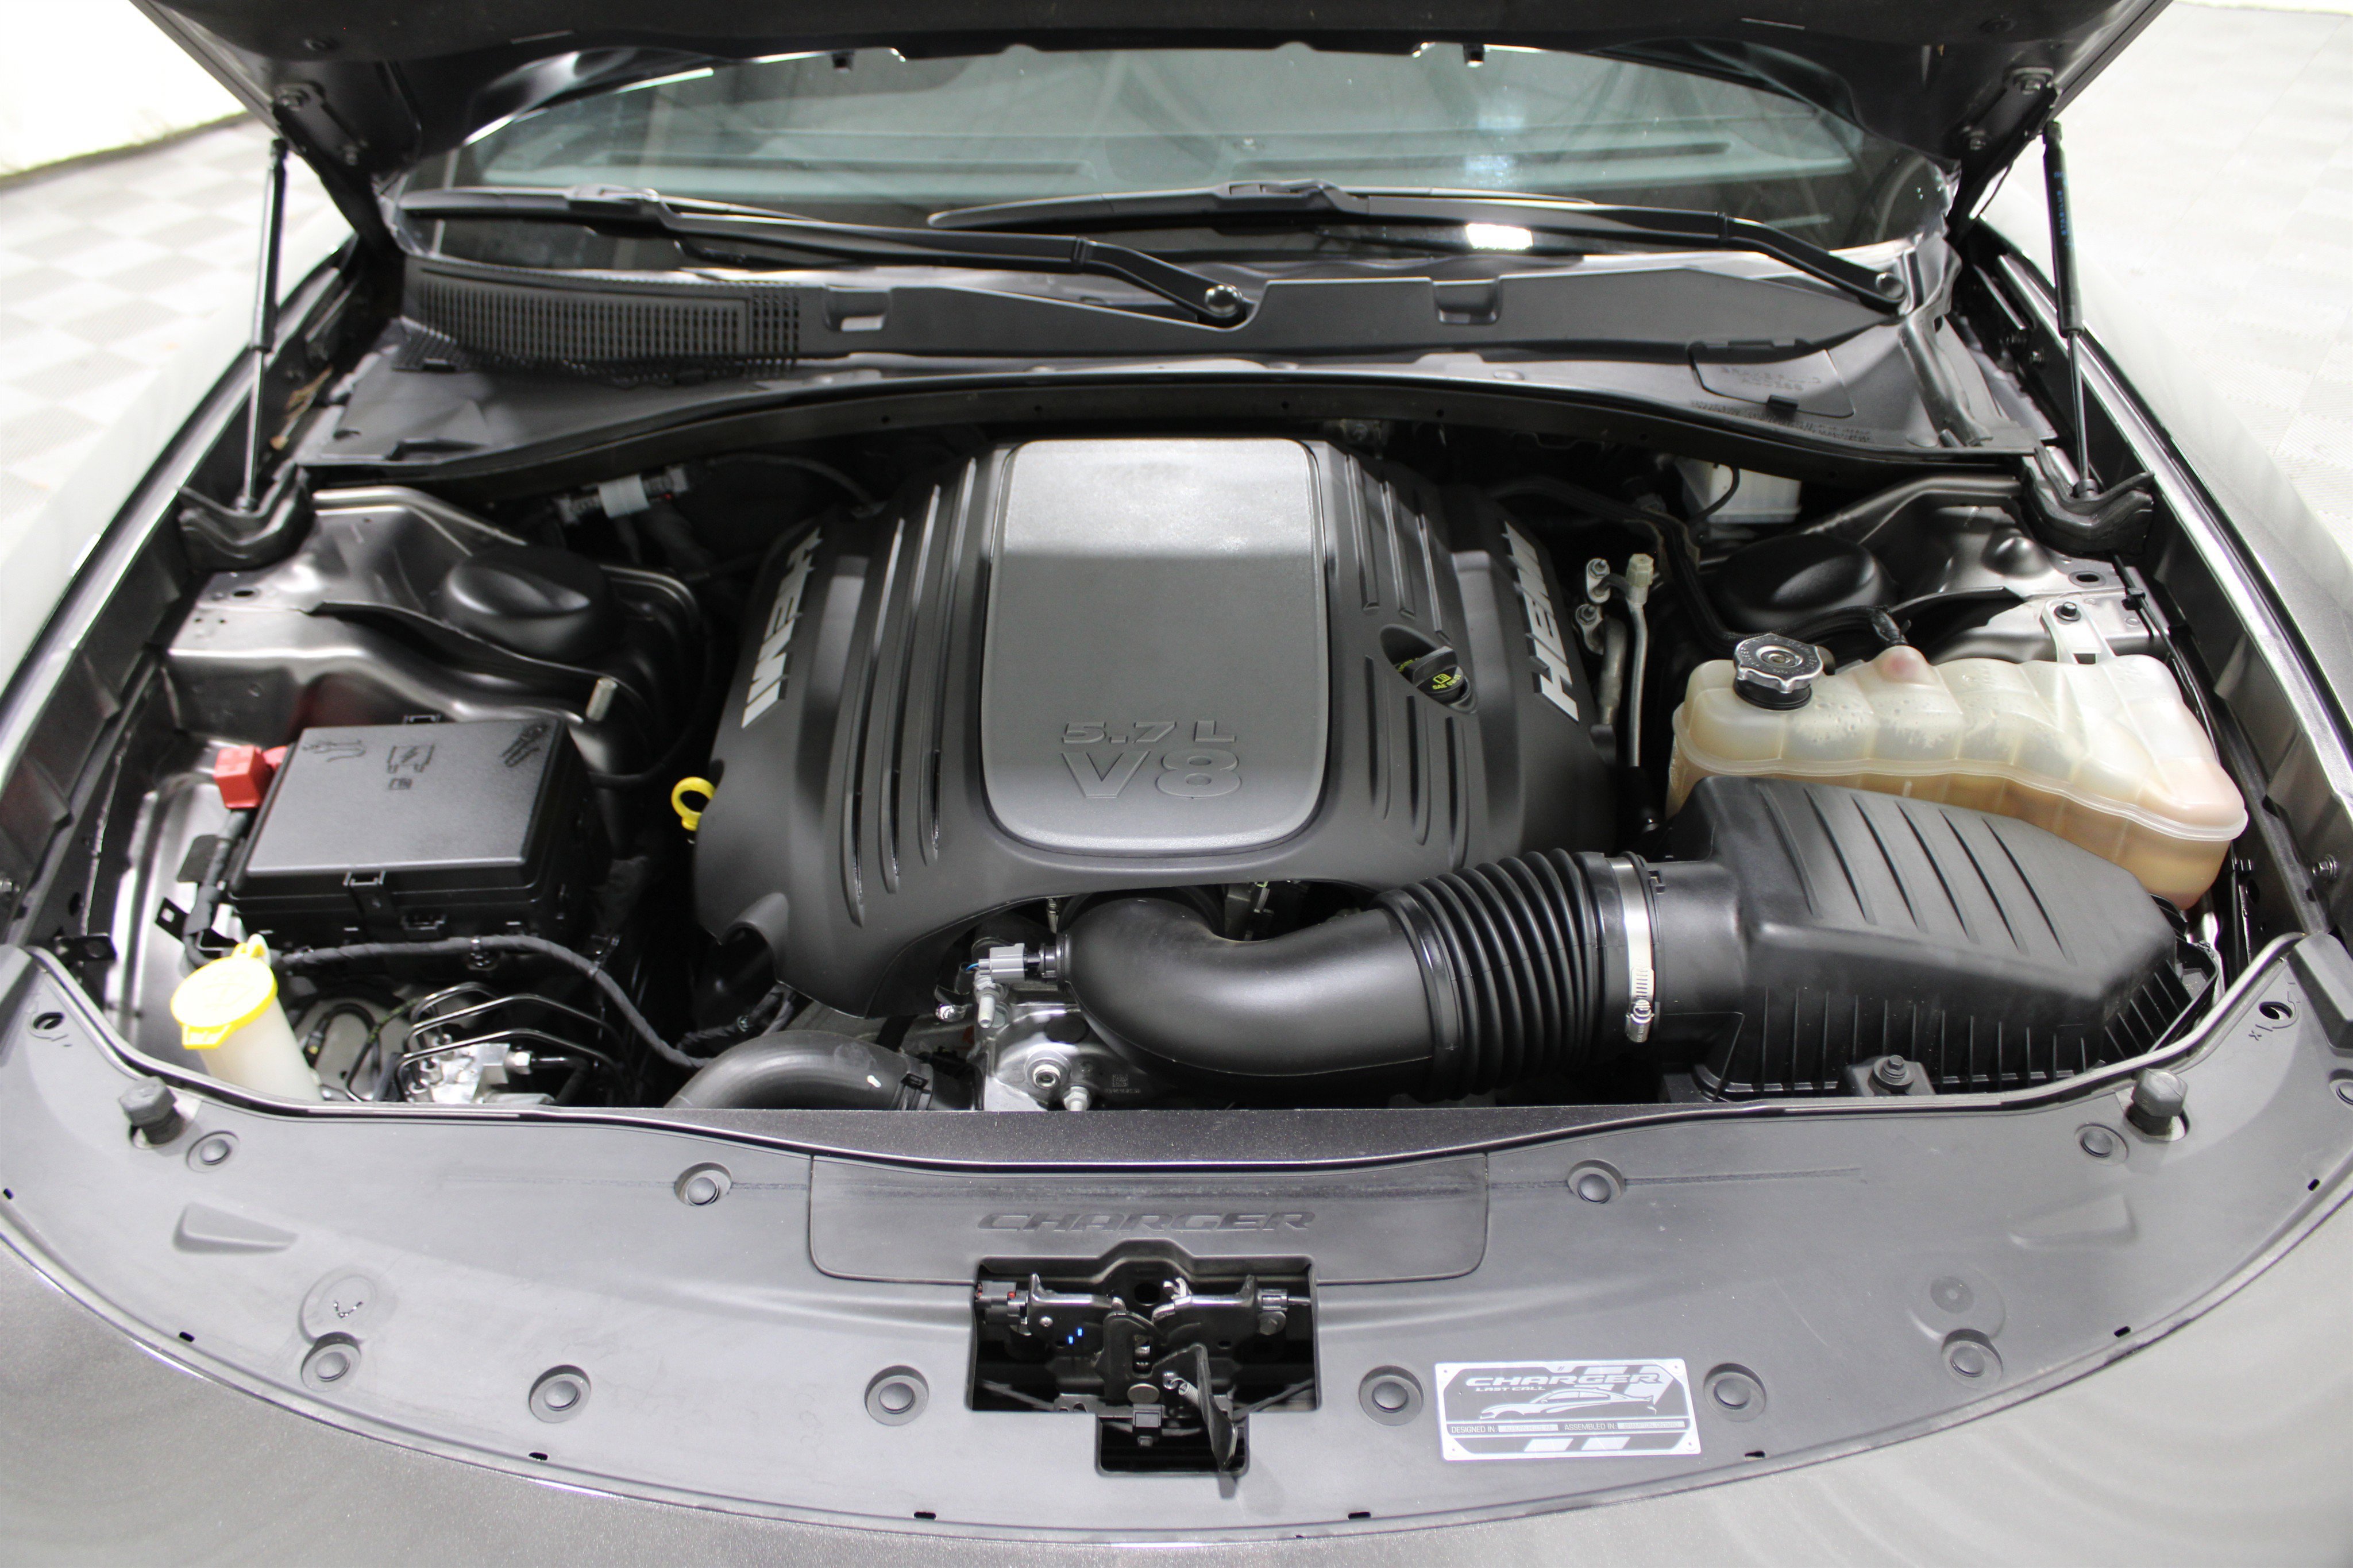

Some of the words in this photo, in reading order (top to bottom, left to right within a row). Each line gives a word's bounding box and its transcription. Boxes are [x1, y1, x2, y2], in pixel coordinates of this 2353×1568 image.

[741, 527, 823, 728] HEMI
[1502, 521, 1579, 722] HEMI
[1060, 748, 1243, 798] V8
[977, 1211, 1316, 1232] CHARGER
[1466, 1373, 1664, 1387] CHARGER
[1451, 1426, 1486, 1434] DESIGNED
[1564, 1423, 1606, 1431] ASSEMBLED
